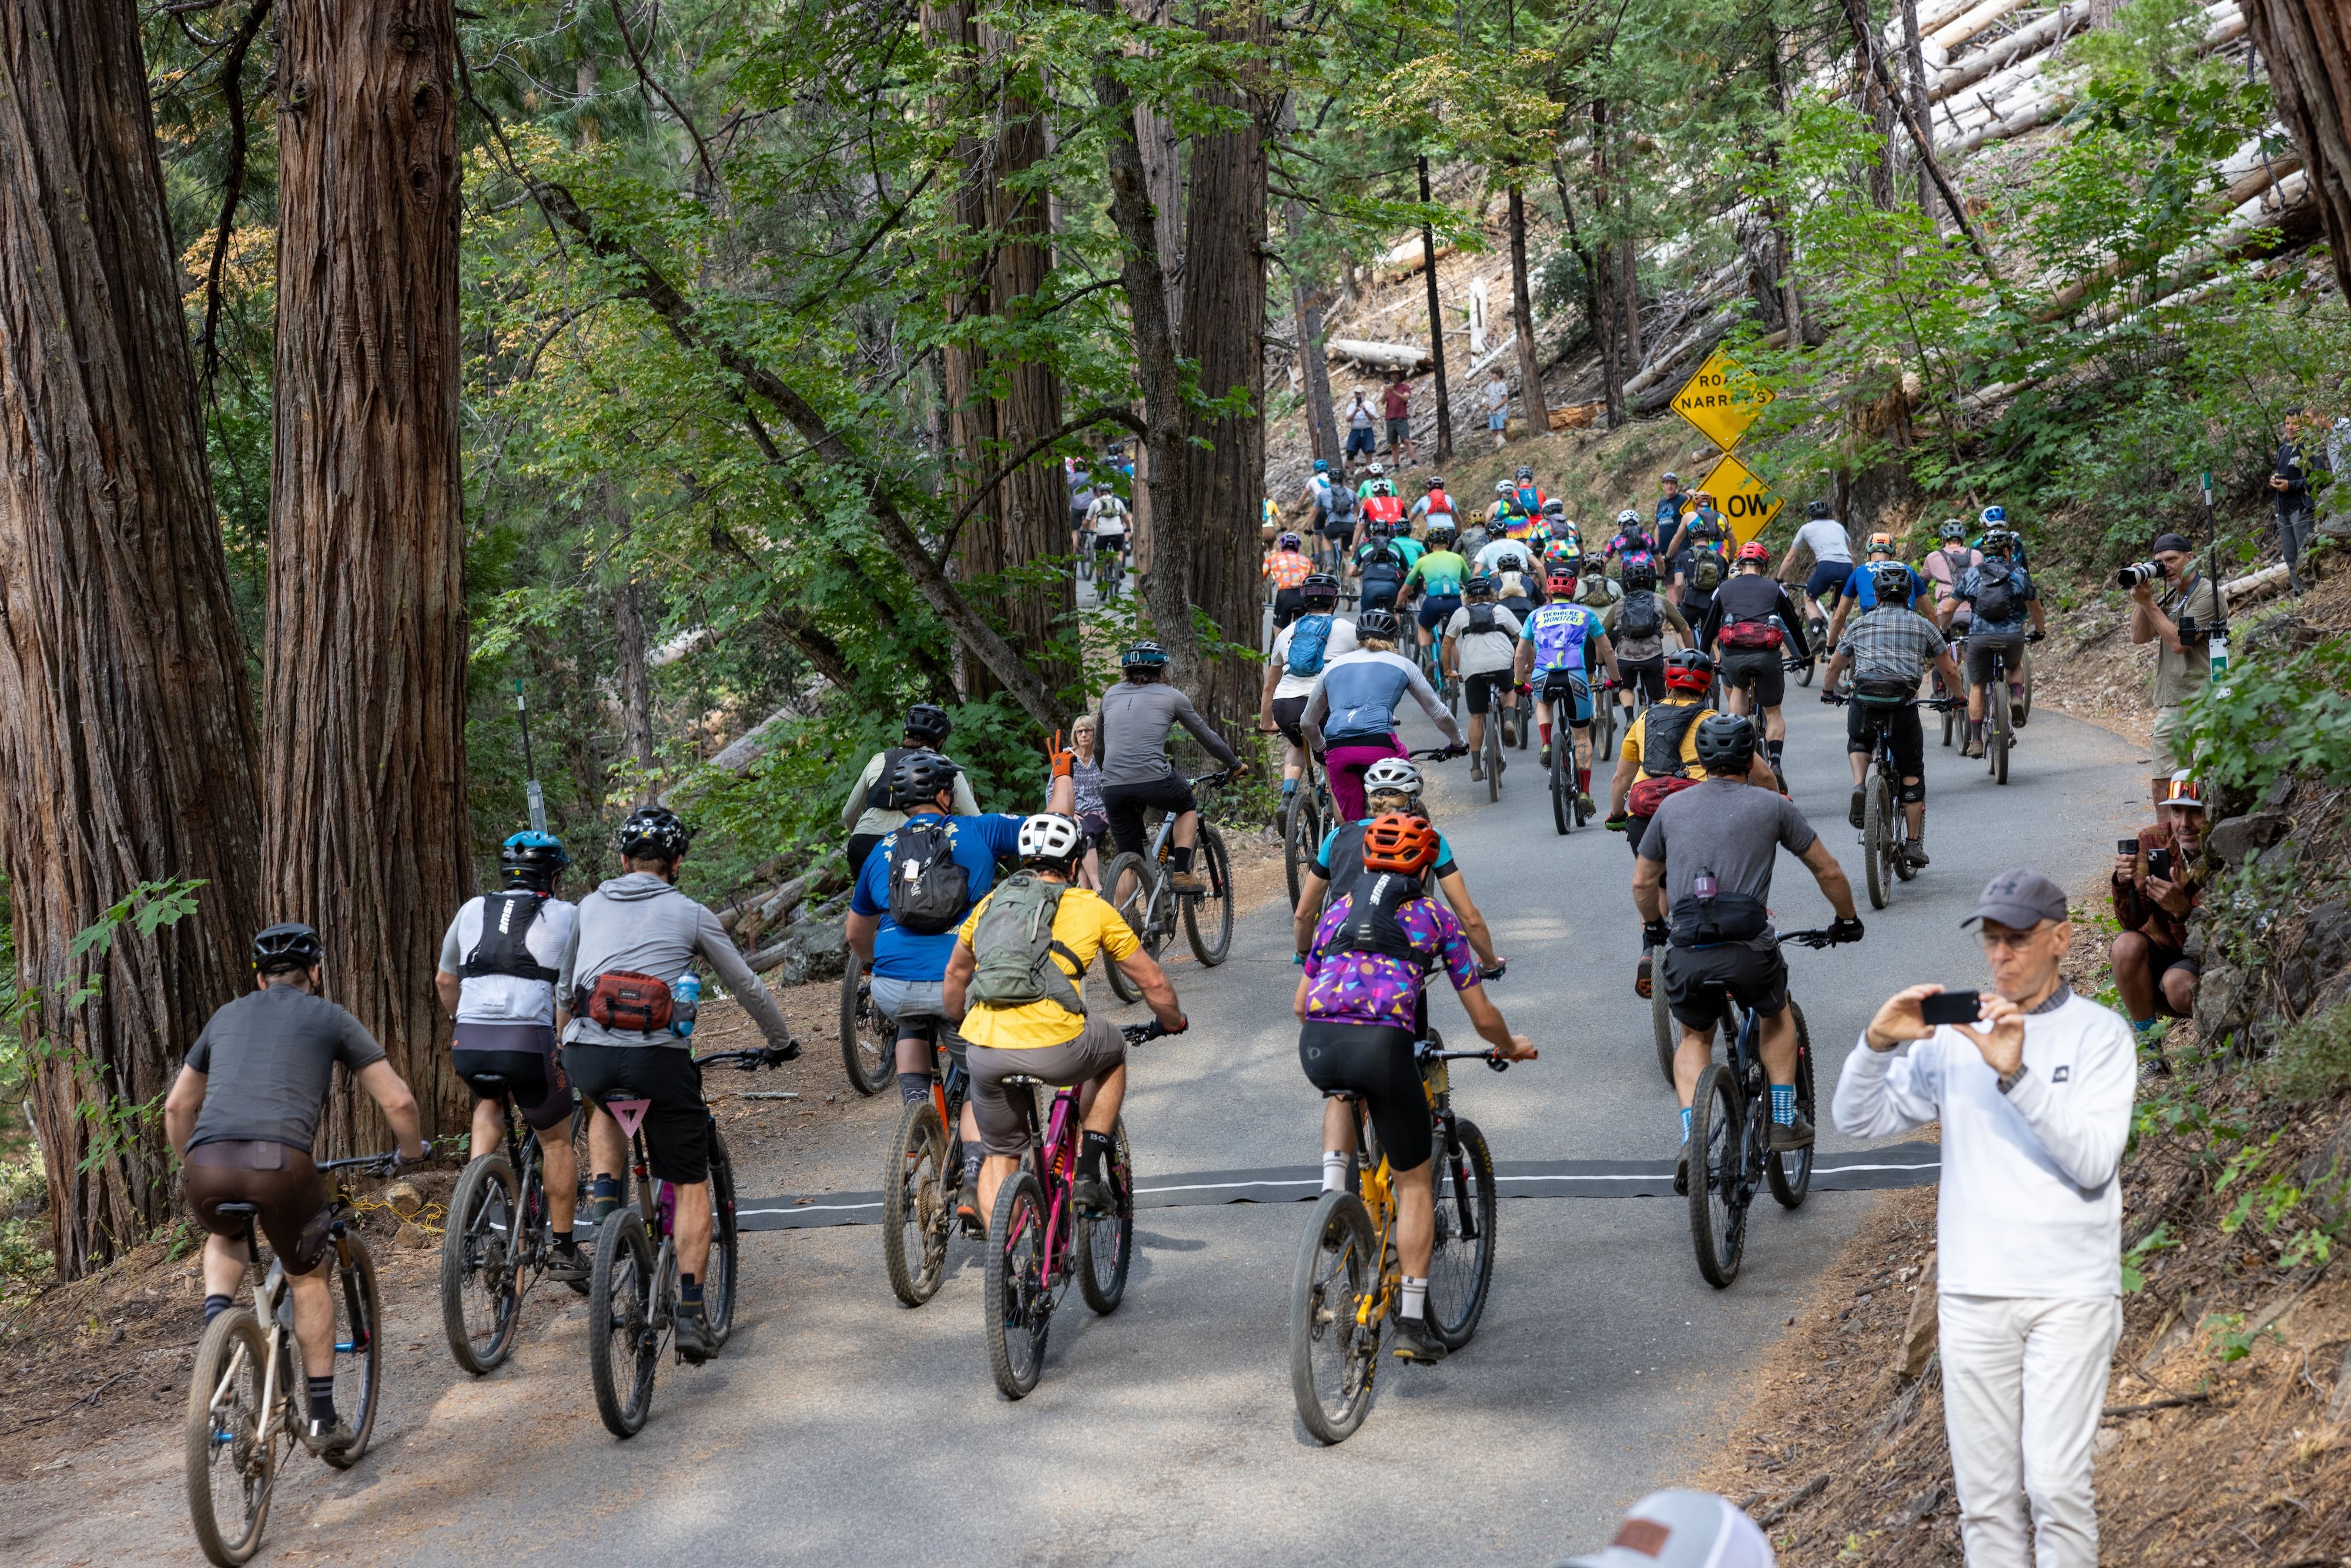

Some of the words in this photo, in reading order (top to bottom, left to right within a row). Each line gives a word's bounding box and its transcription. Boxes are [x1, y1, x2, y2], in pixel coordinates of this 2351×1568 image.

[1699, 373, 1743, 387] RO
[1682, 391, 1766, 409] NARRS
[1712, 494, 1768, 518] LOW
[1369, 874, 1391, 906] USWE
[498, 899, 515, 934] USWE
